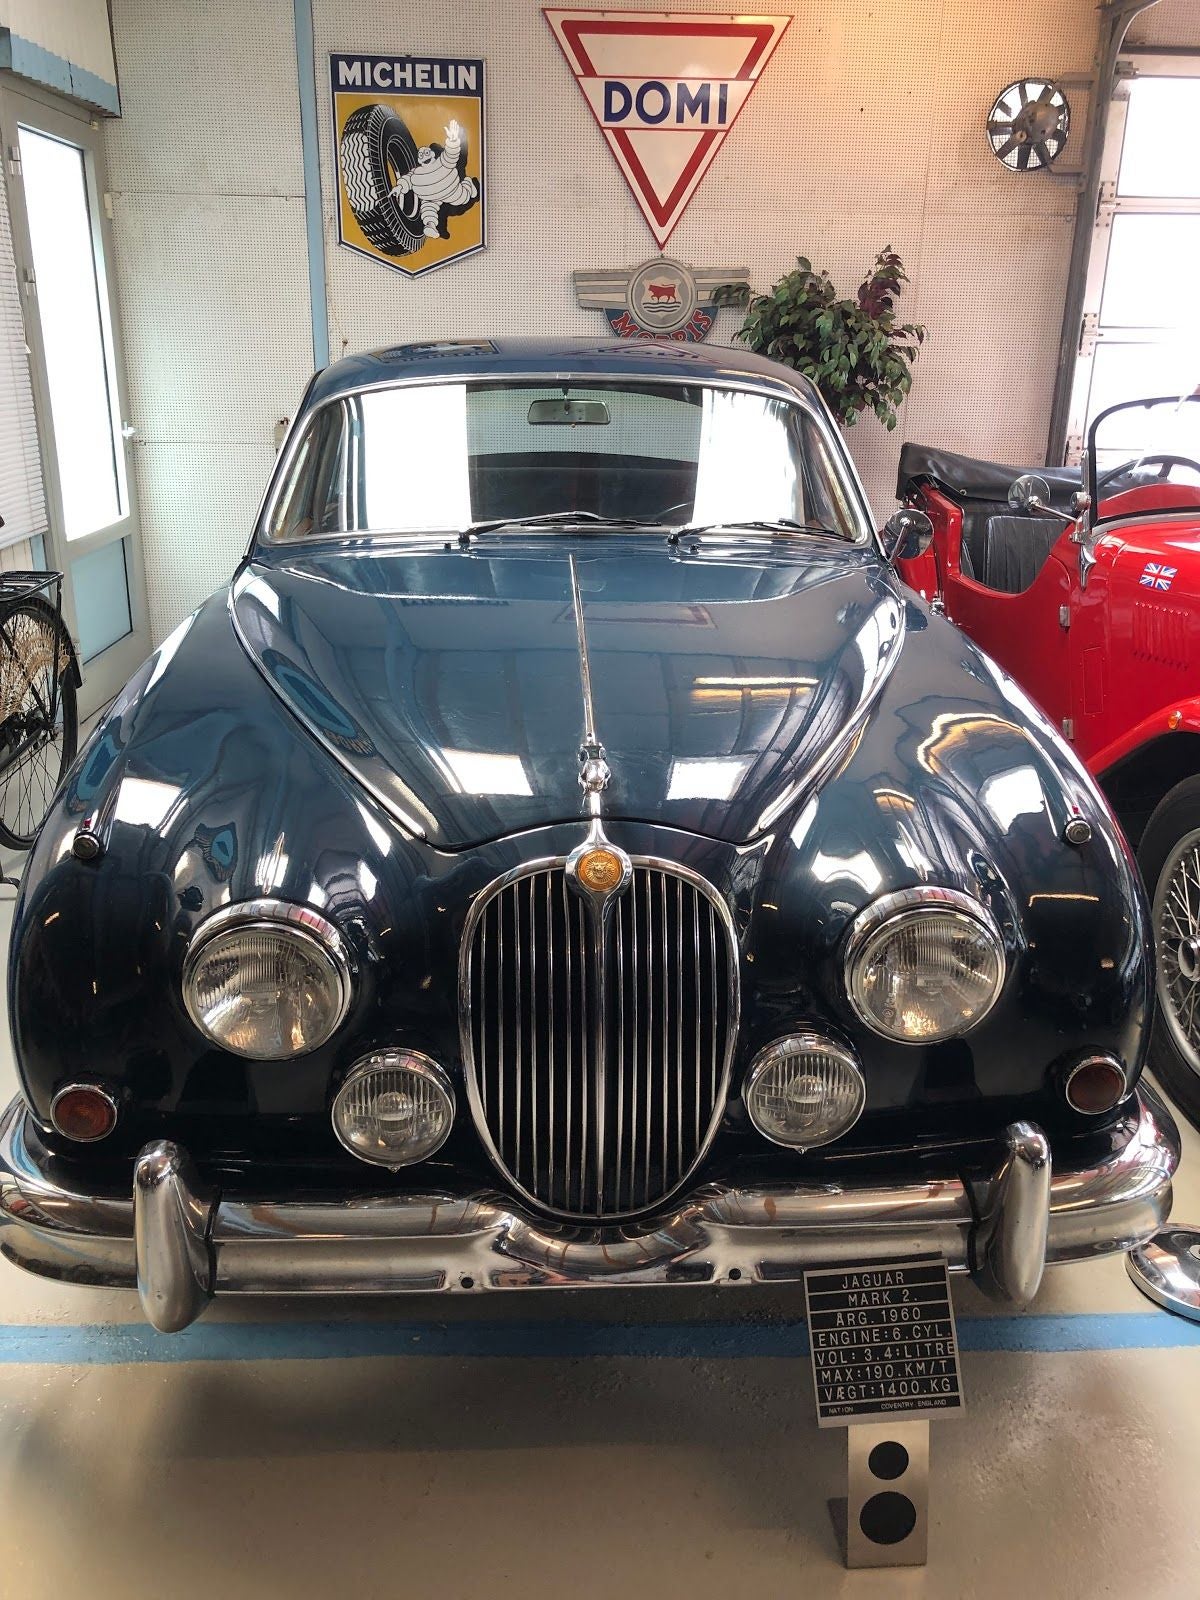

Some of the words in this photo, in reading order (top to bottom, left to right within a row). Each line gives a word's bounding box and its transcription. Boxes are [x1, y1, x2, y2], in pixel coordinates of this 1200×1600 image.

[338, 60, 477, 90] MICHELIN
[603, 80, 728, 125] DOMI
[842, 1271, 905, 1290] JAGUAR
[848, 1290, 892, 1307] MARK
[880, 1401, 914, 1411] COVENTRY
[917, 1399, 947, 1408] ENGLAND
